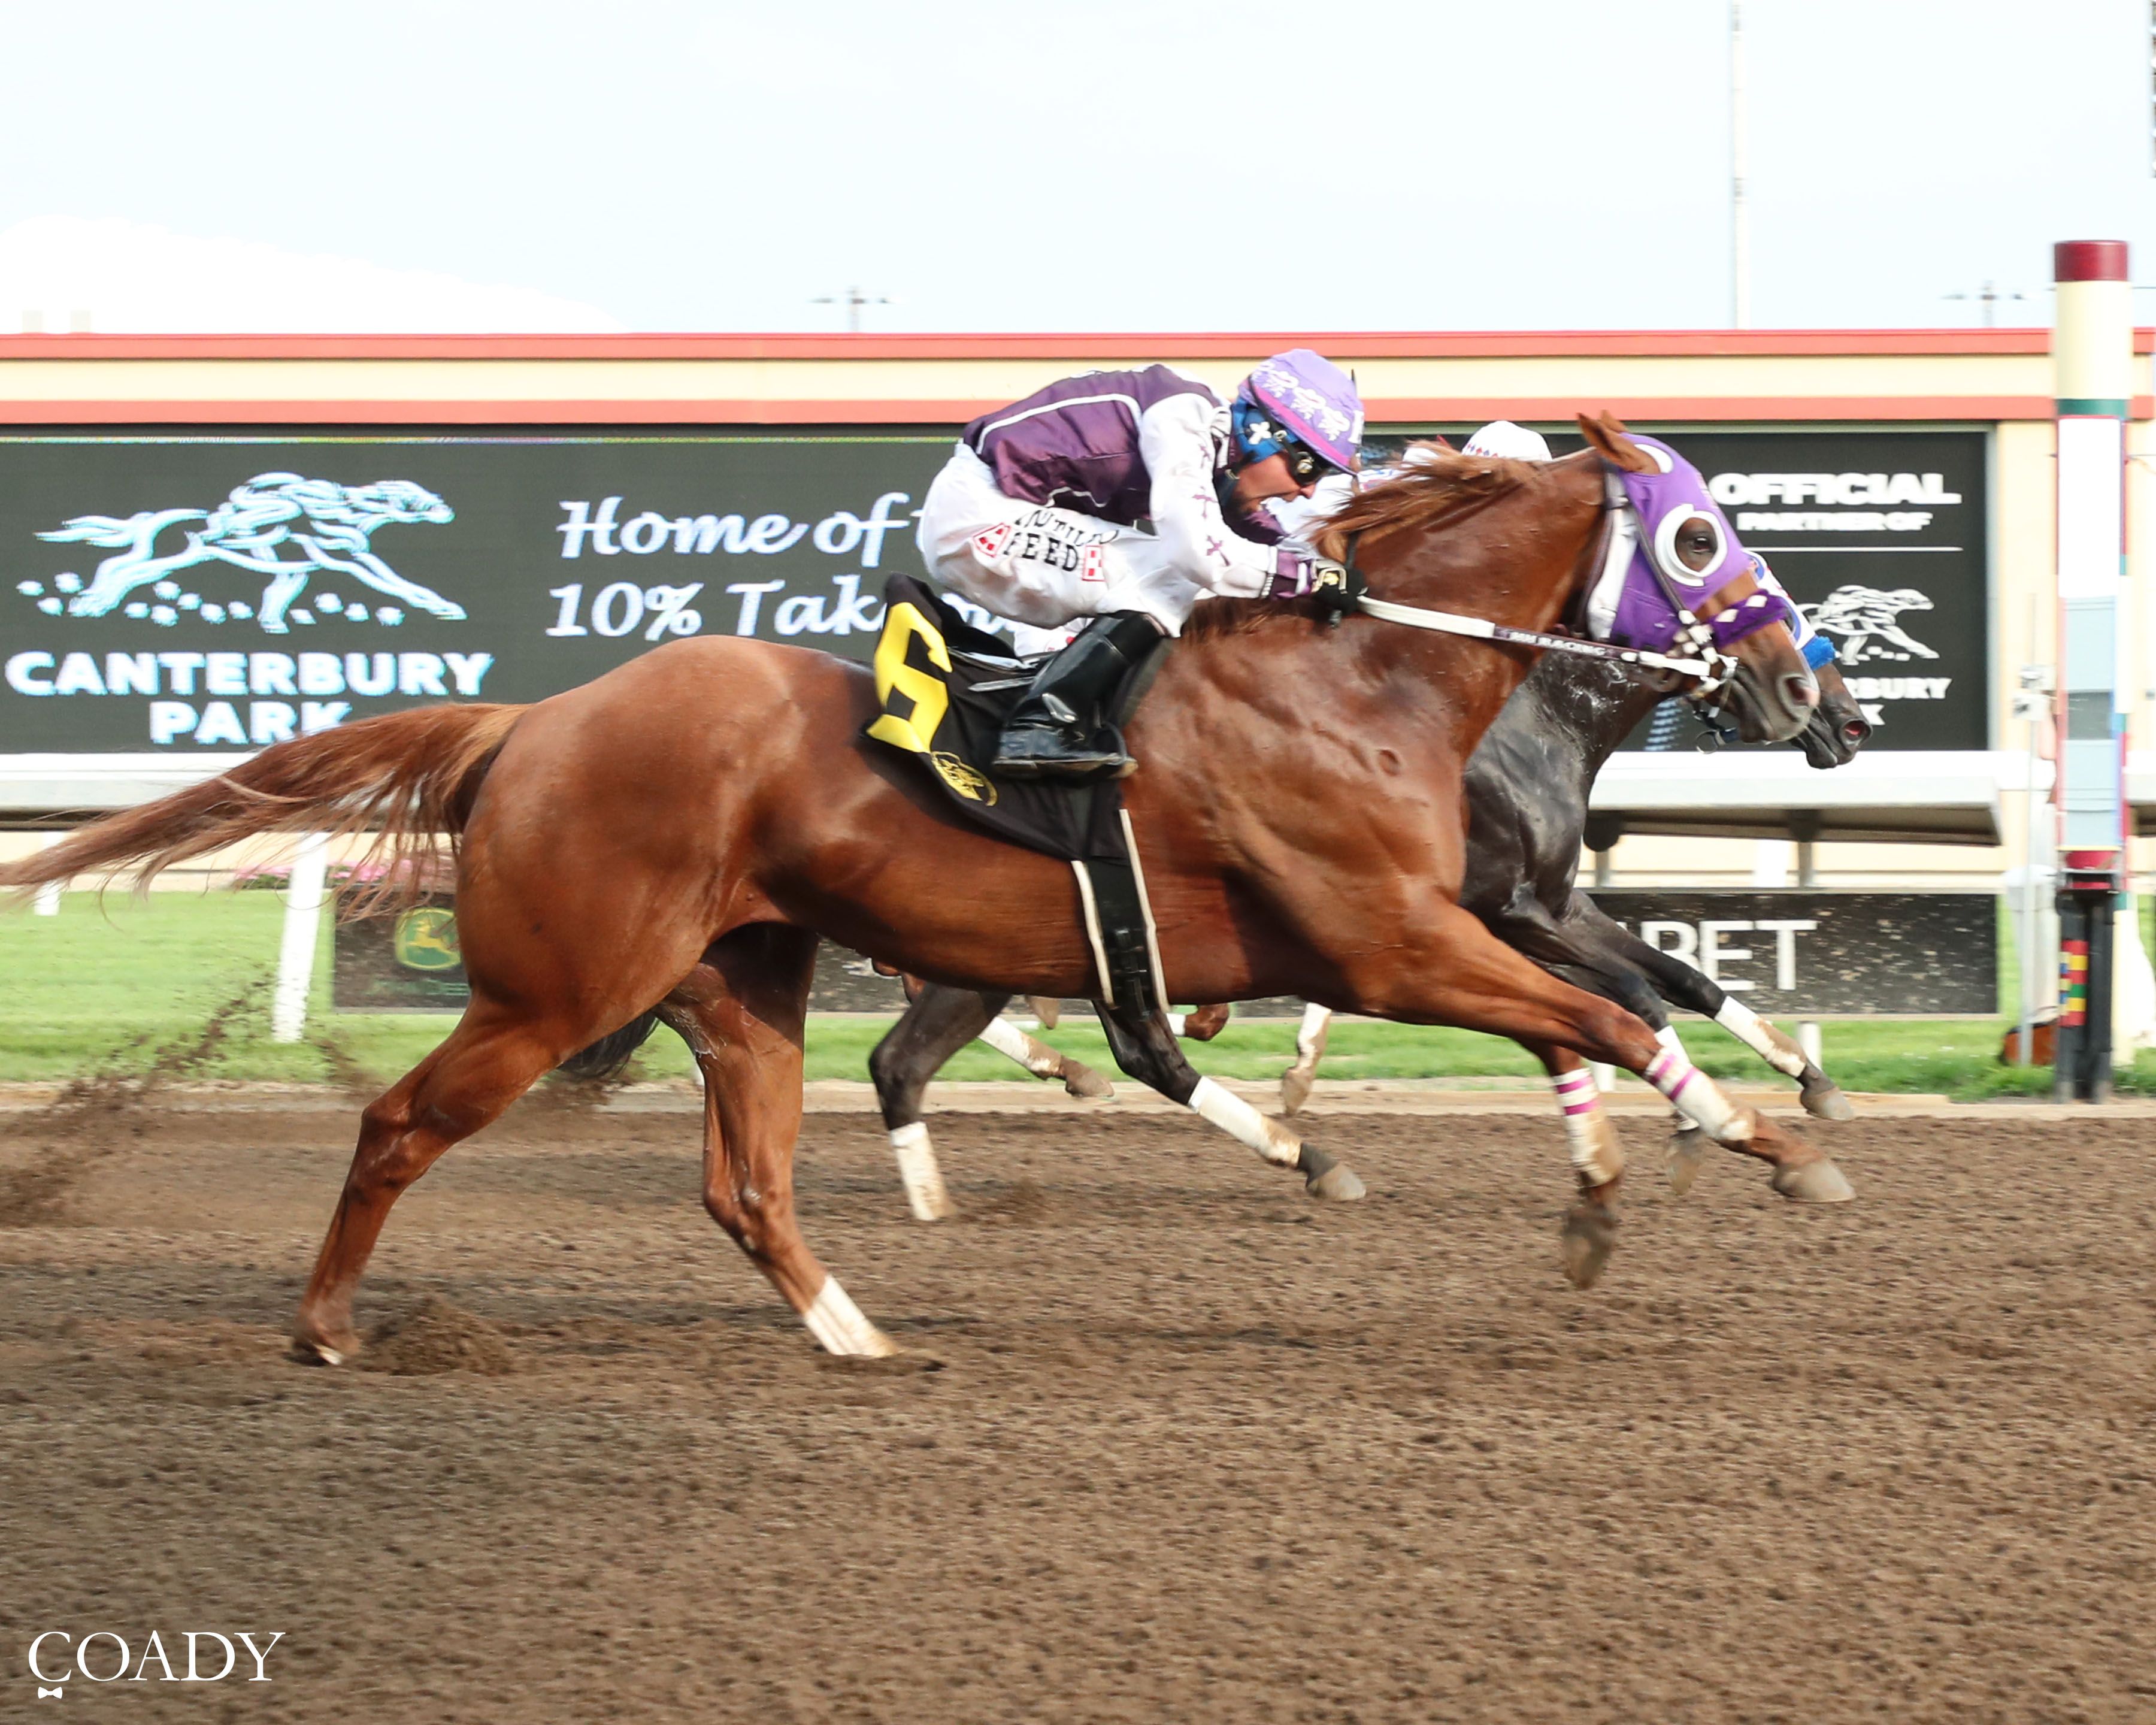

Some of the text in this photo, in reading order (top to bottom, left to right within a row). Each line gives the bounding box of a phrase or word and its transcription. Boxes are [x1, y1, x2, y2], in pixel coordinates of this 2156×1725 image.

[1708, 473, 1963, 506] OFFICIAL
[556, 496, 809, 558] Home
[813, 492, 910, 567] of
[546, 582, 705, 641] 10%
[4, 650, 495, 696] CANTERBURY
[149, 701, 353, 745] PARK
